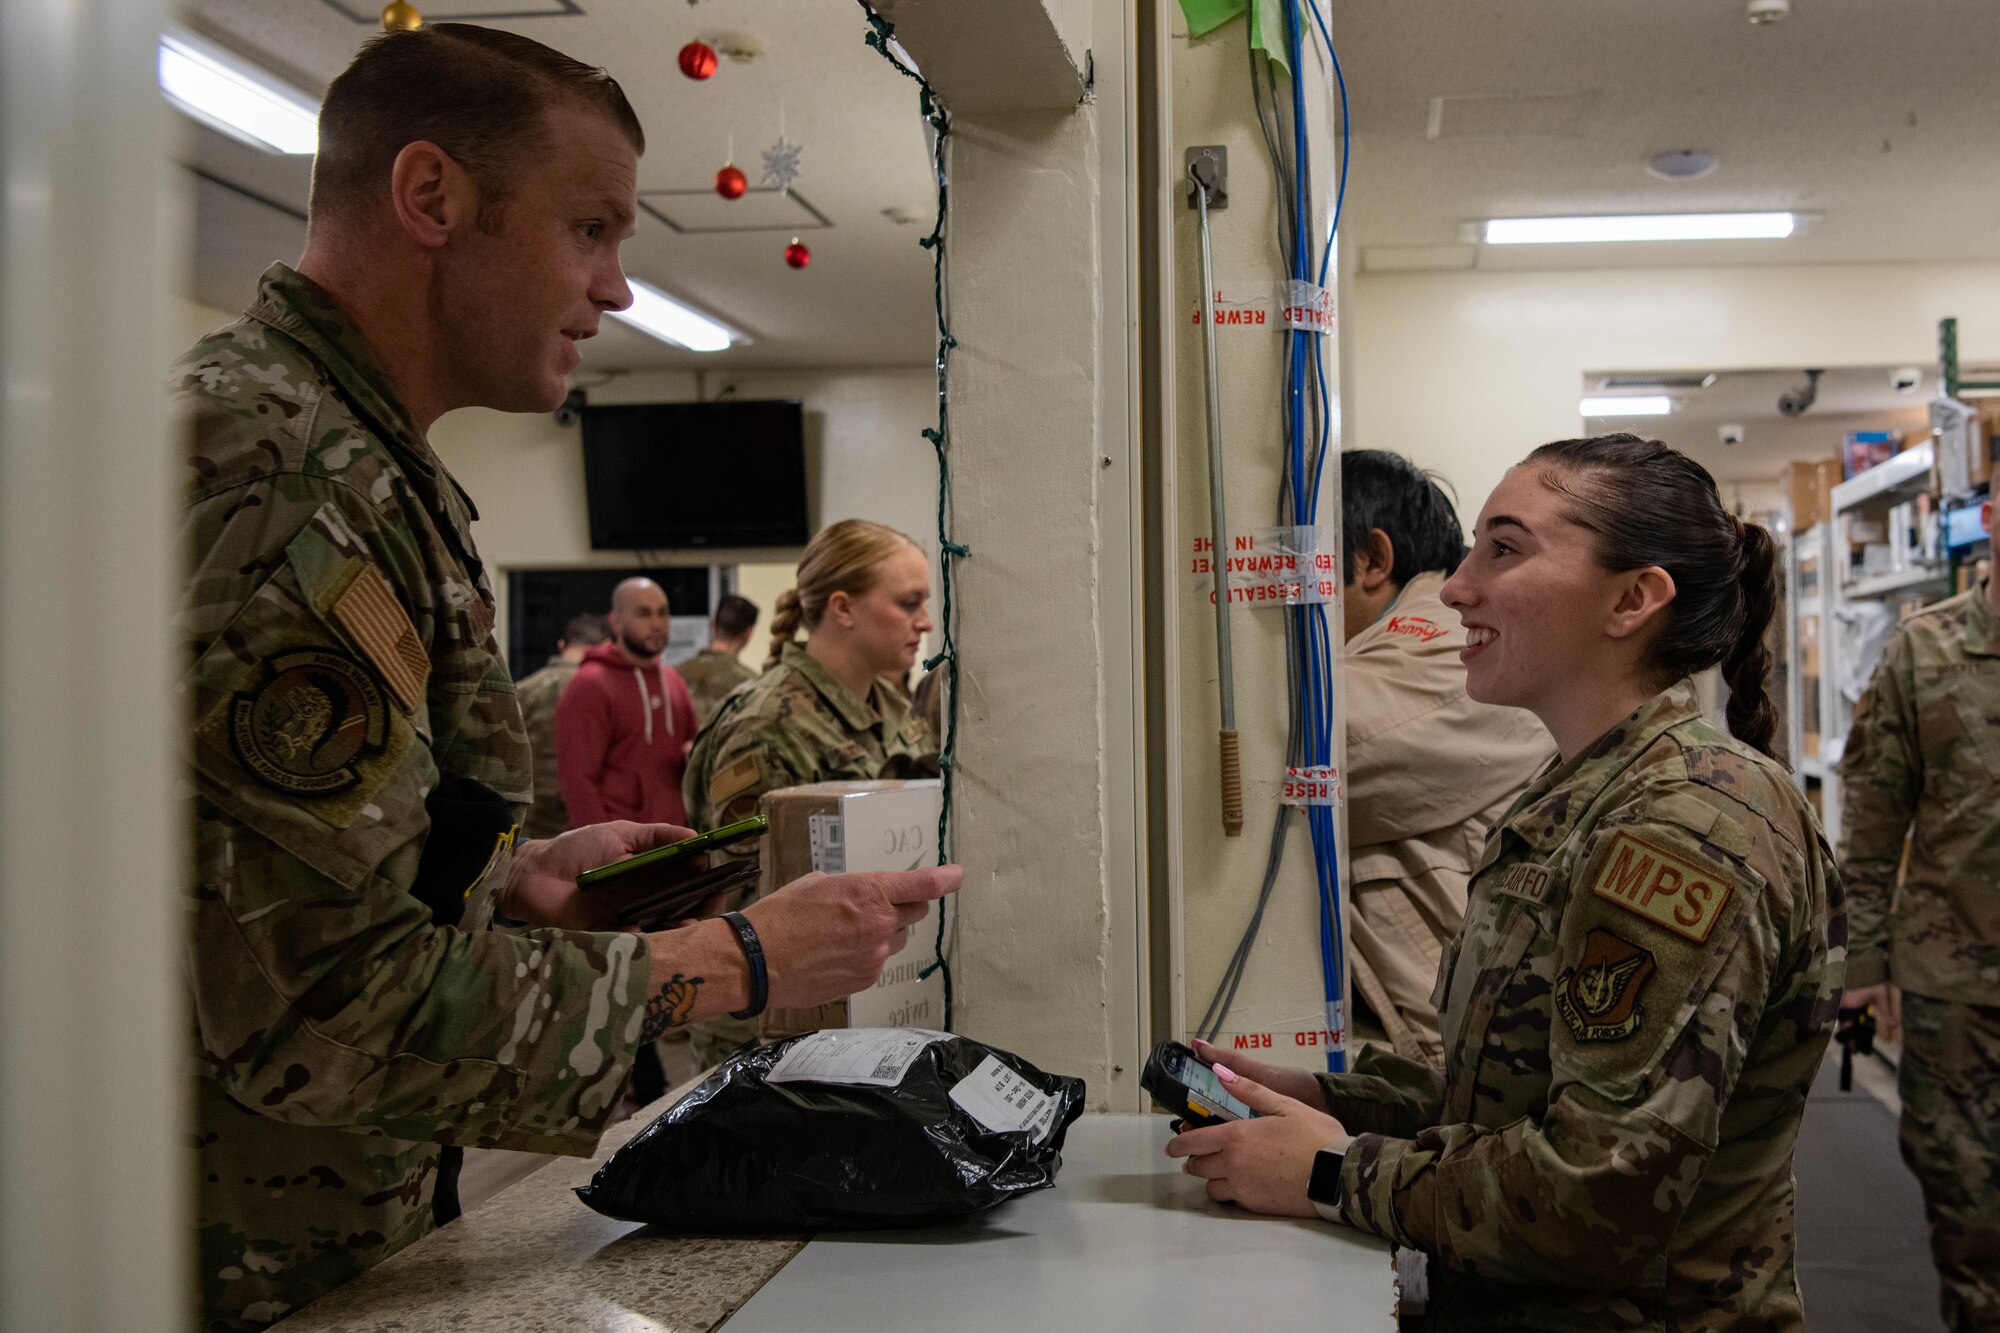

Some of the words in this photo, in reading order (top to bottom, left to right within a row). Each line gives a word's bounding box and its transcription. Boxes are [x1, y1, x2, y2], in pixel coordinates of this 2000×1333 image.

[1192, 310, 1265, 325] REWRP
[1194, 537, 1226, 552] HE
[1236, 536, 1253, 551] IN
[1603, 843, 1713, 927] MPS
[1233, 1033, 1272, 1049] REW
[1295, 1030, 1344, 1047] ALED
